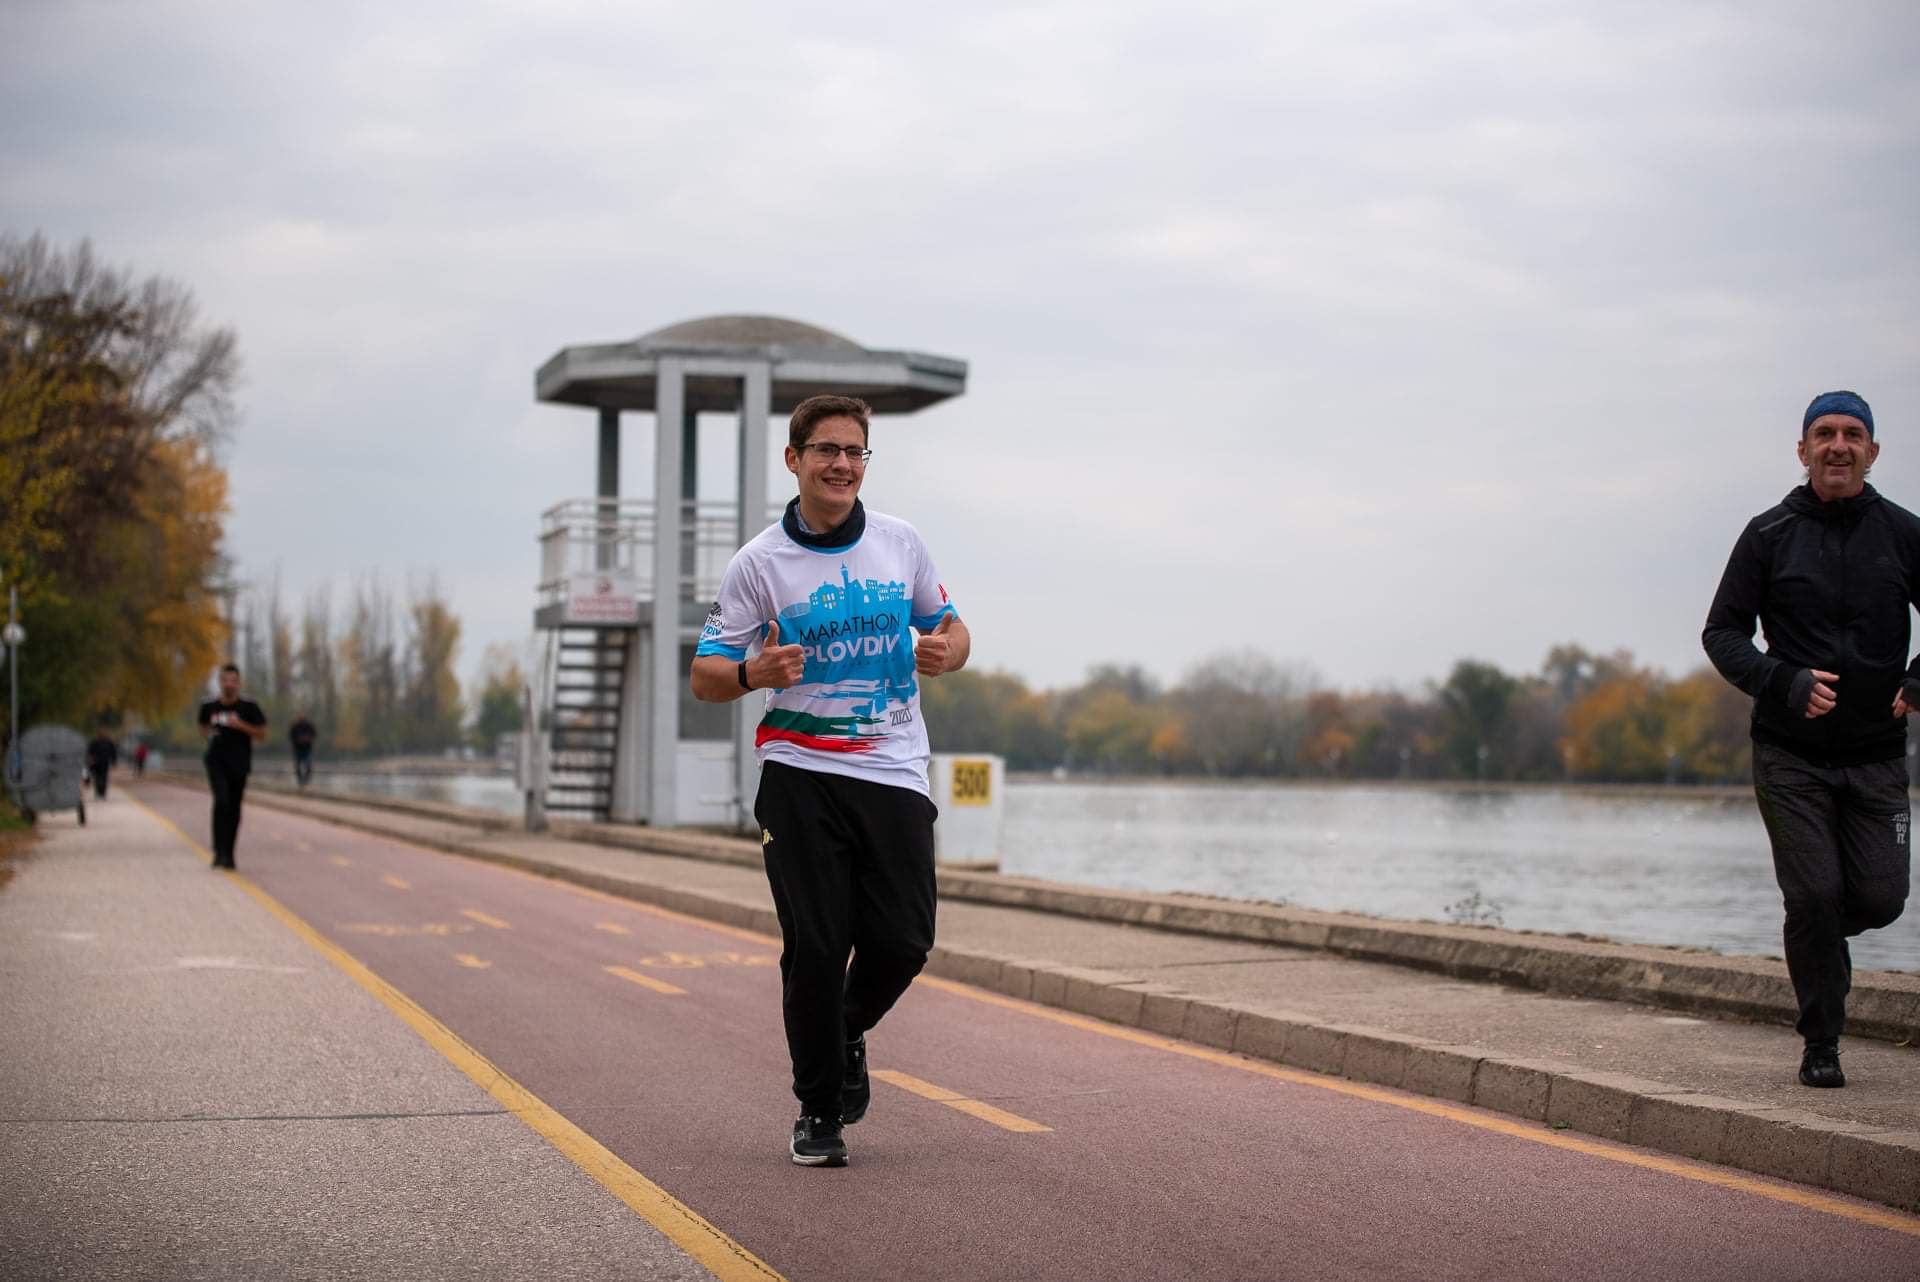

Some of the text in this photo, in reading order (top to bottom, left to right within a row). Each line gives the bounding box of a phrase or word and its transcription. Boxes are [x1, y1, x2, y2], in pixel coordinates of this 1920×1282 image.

[800, 612, 900, 643] MARATHON
[802, 633, 900, 663] PLOVDIV
[889, 707, 913, 727] 2020
[954, 767, 988, 797] 500
